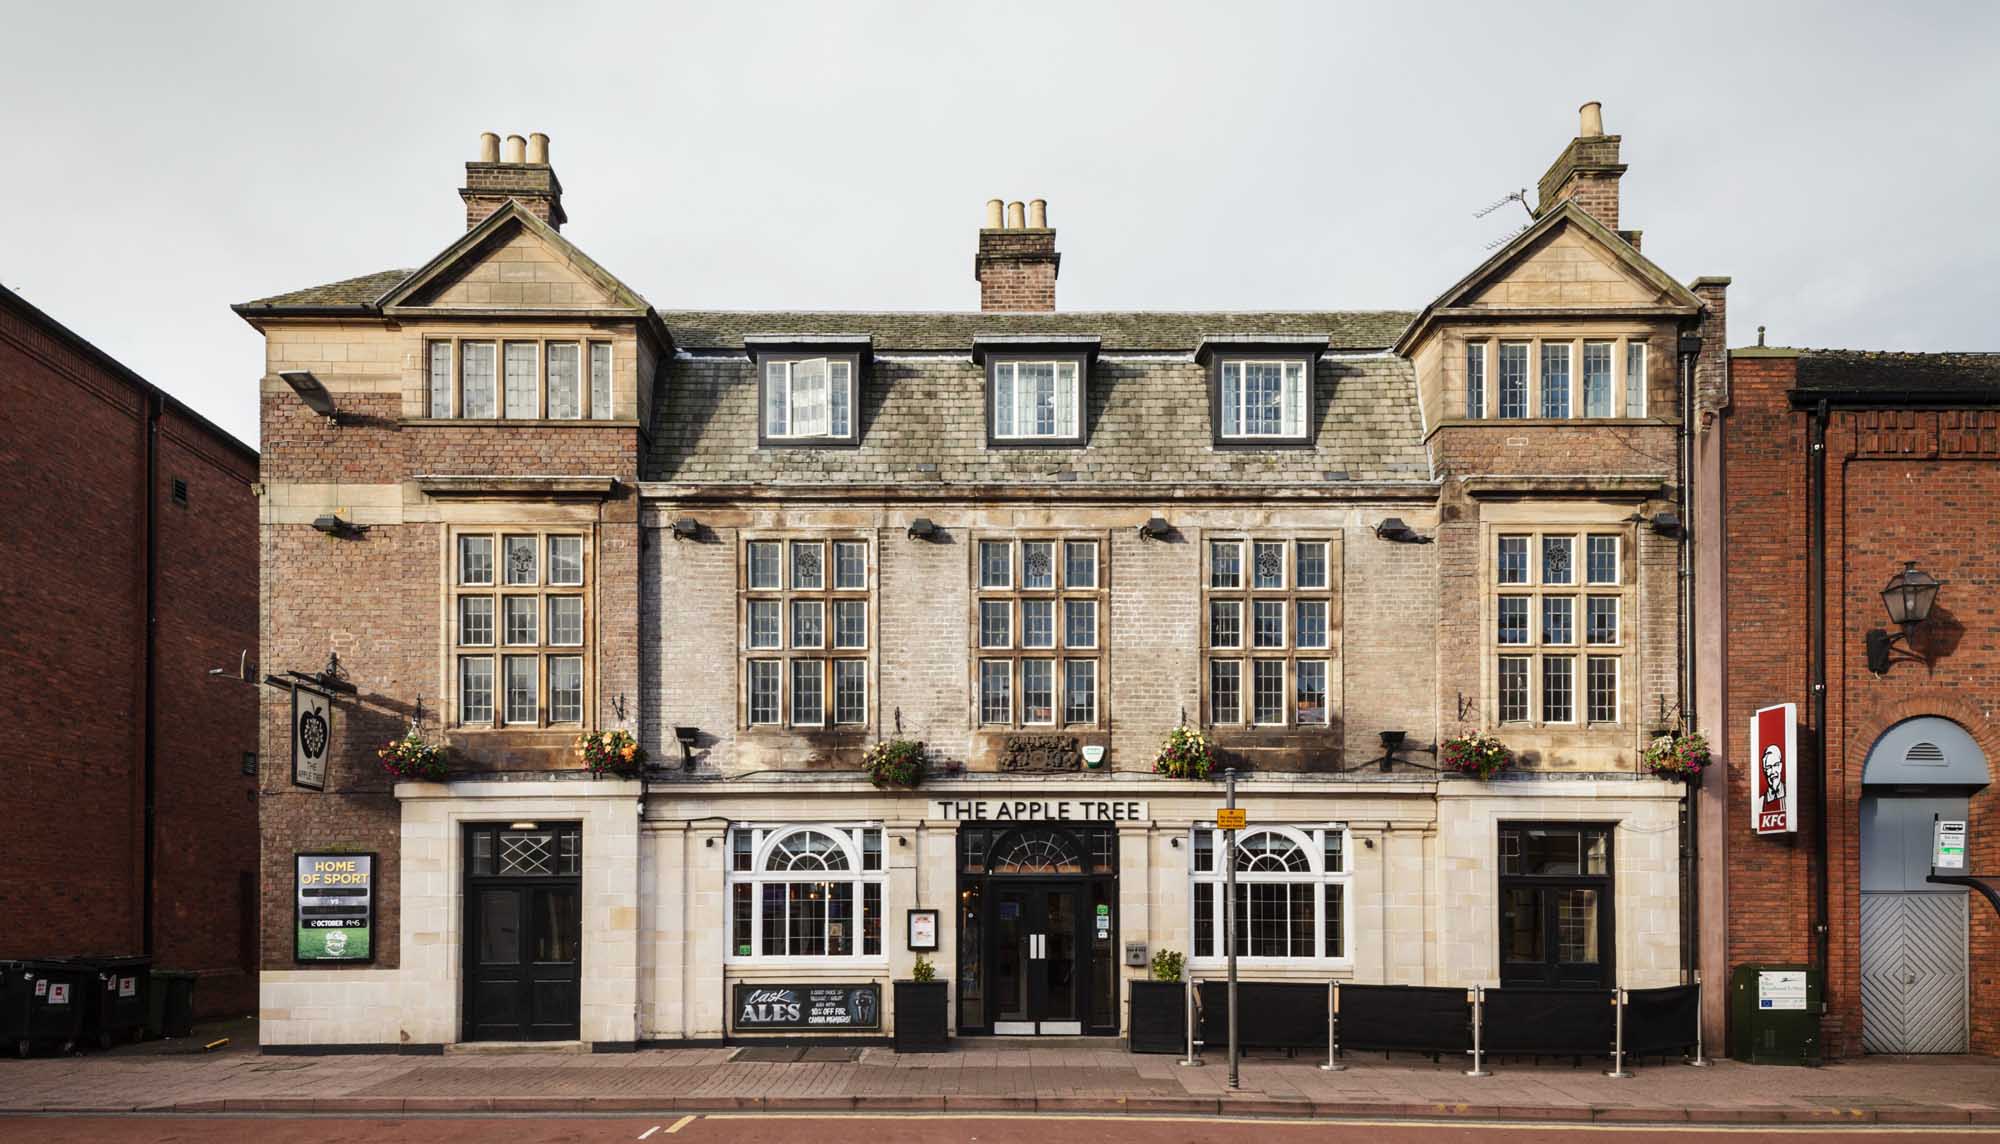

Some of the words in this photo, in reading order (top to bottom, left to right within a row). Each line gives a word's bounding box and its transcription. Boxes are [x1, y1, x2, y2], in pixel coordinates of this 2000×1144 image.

[306, 760, 318, 772] THE
[938, 801, 987, 820] THE
[997, 801, 1070, 820] APPLE
[1080, 801, 1140, 820] TREE
[1761, 813, 1786, 827] KFC
[315, 861, 356, 872] HOME
[302, 873, 320, 884] OF
[323, 873, 369, 884] SPORT
[749, 989, 791, 1004] Cask
[740, 1003, 801, 1022] ALES
[823, 1007, 835, 1015] OFF
[835, 1007, 847, 1015] FOR
